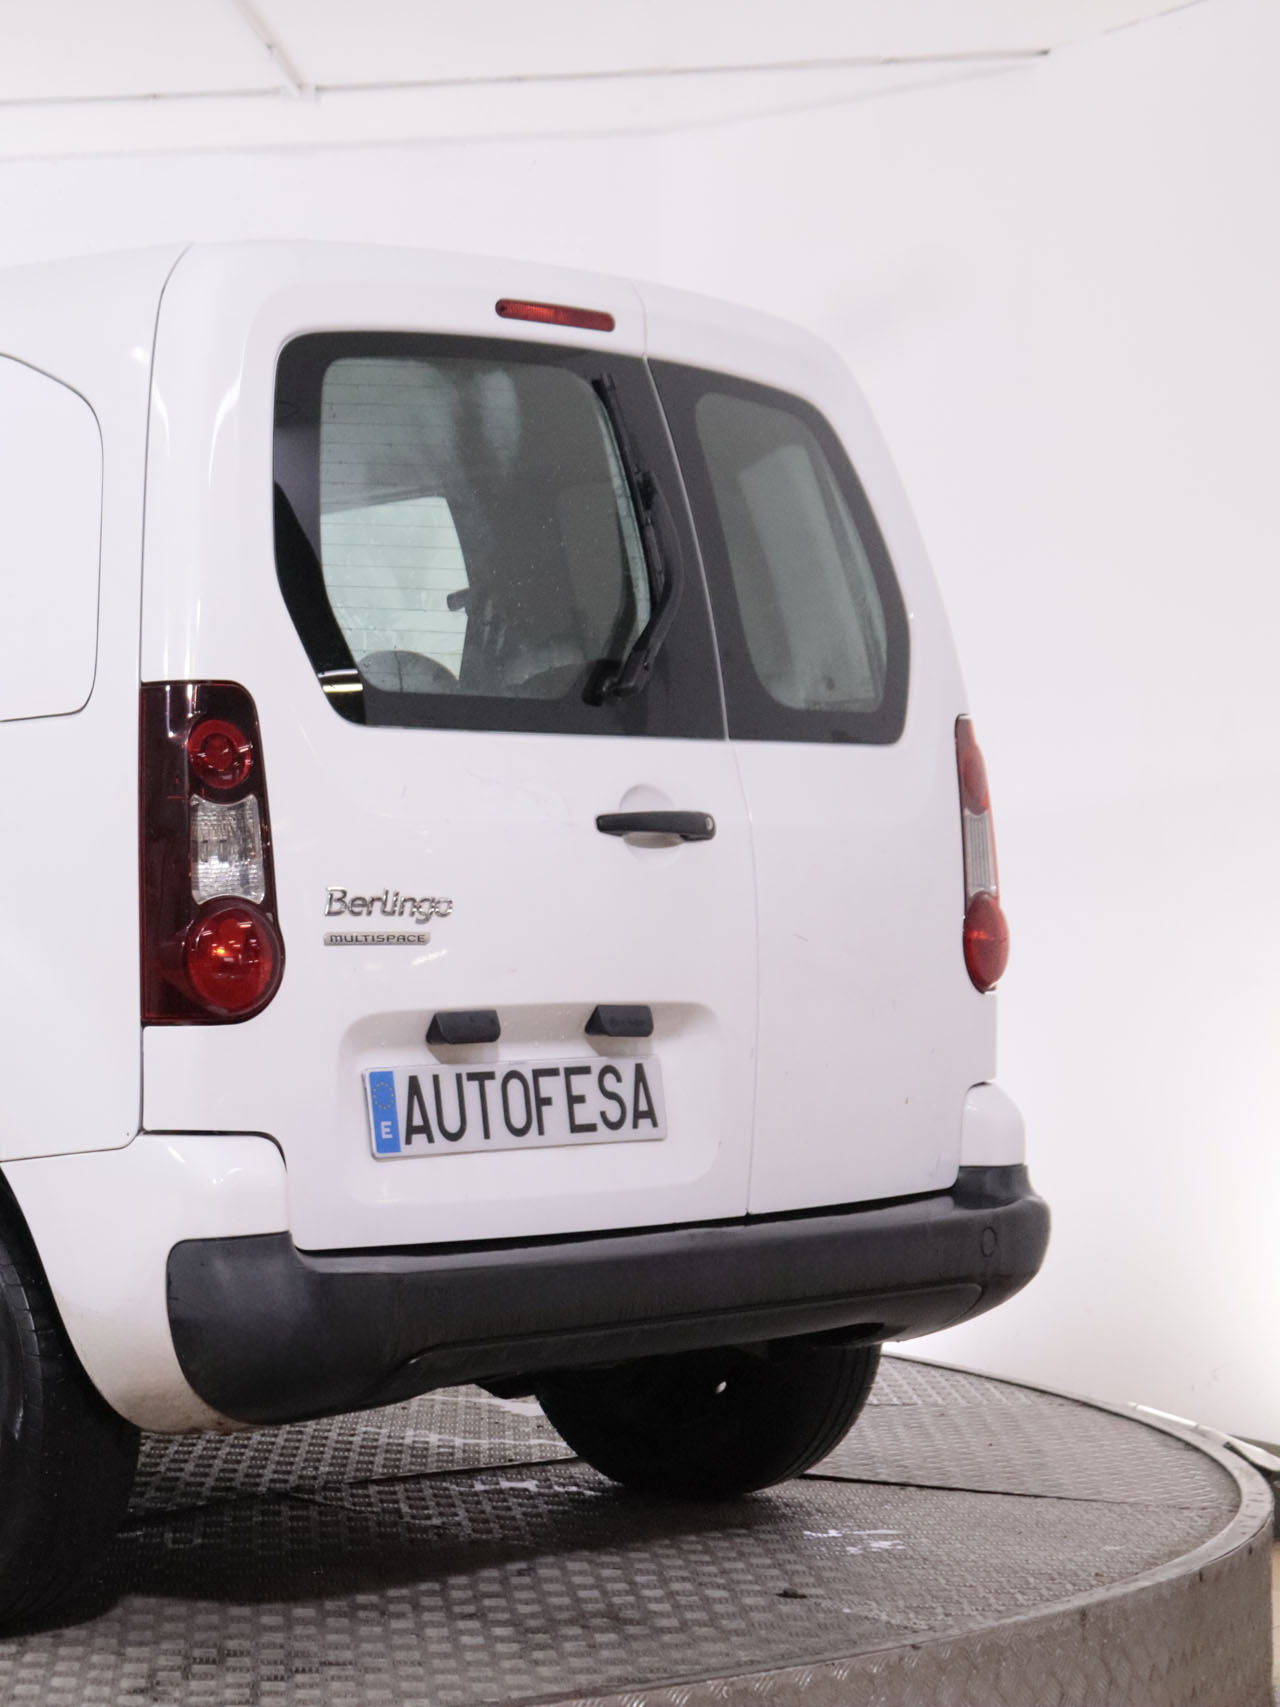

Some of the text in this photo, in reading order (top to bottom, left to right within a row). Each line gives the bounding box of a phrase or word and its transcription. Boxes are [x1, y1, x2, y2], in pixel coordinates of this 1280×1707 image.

[325, 886, 453, 924] Berlingo
[329, 934, 426, 944] MULTISPACE
[405, 1063, 658, 1145] AUTOFESA
[381, 1121, 393, 1140] E
